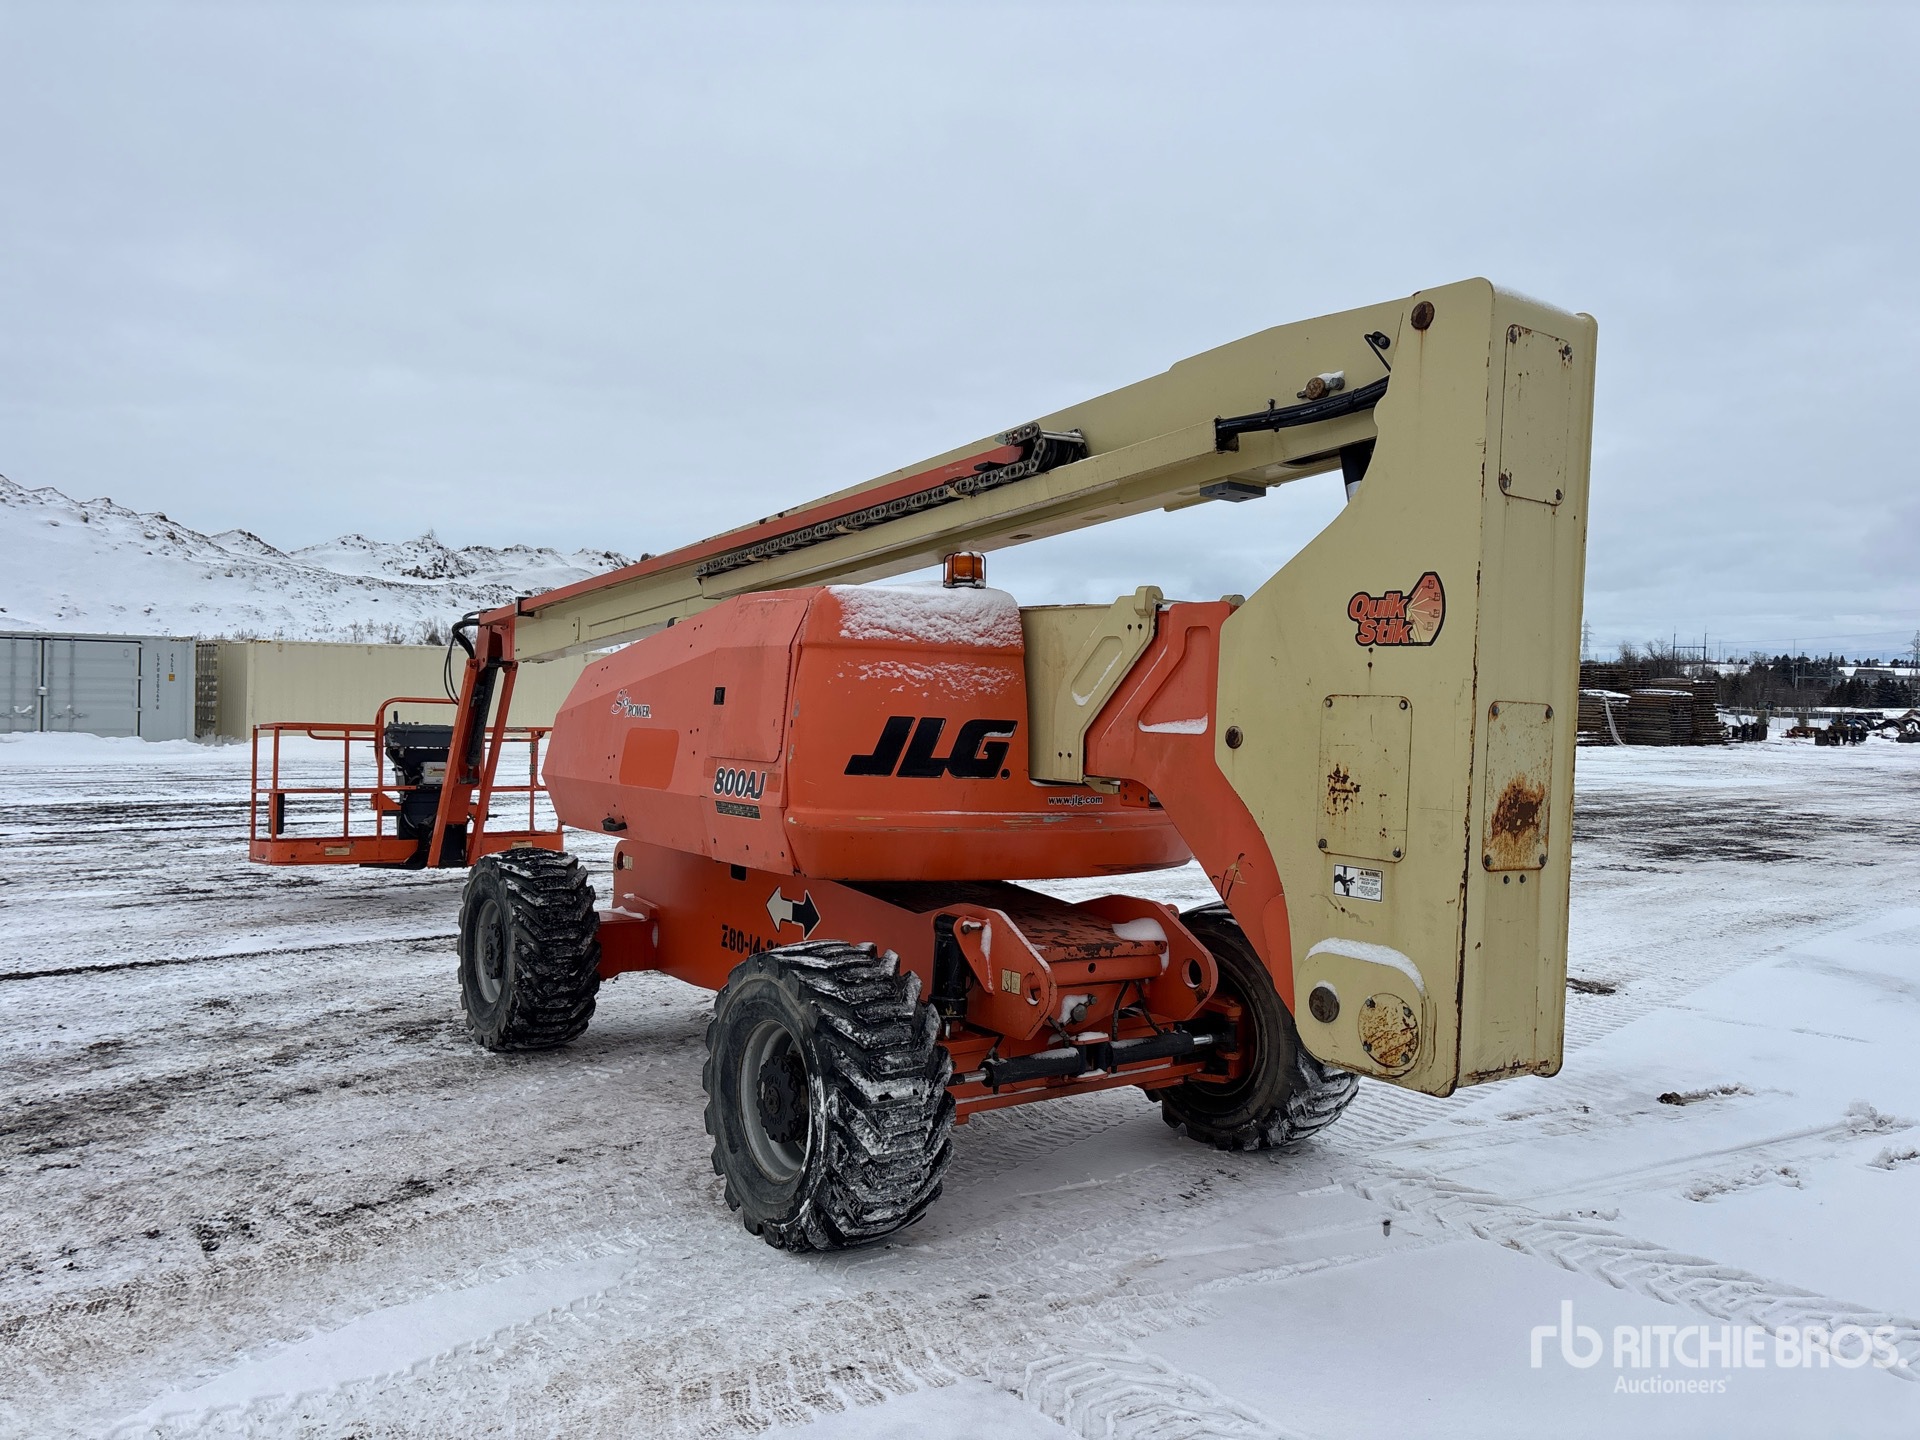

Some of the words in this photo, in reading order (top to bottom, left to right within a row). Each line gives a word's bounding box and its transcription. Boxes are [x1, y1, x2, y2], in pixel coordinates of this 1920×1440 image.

[1349, 593, 1409, 622] Quik
[1356, 619, 1412, 645] Stik
[627, 704, 650, 718] POWER
[713, 766, 767, 801] 800AJ
[1048, 795, 1103, 807] www.jlg.com
